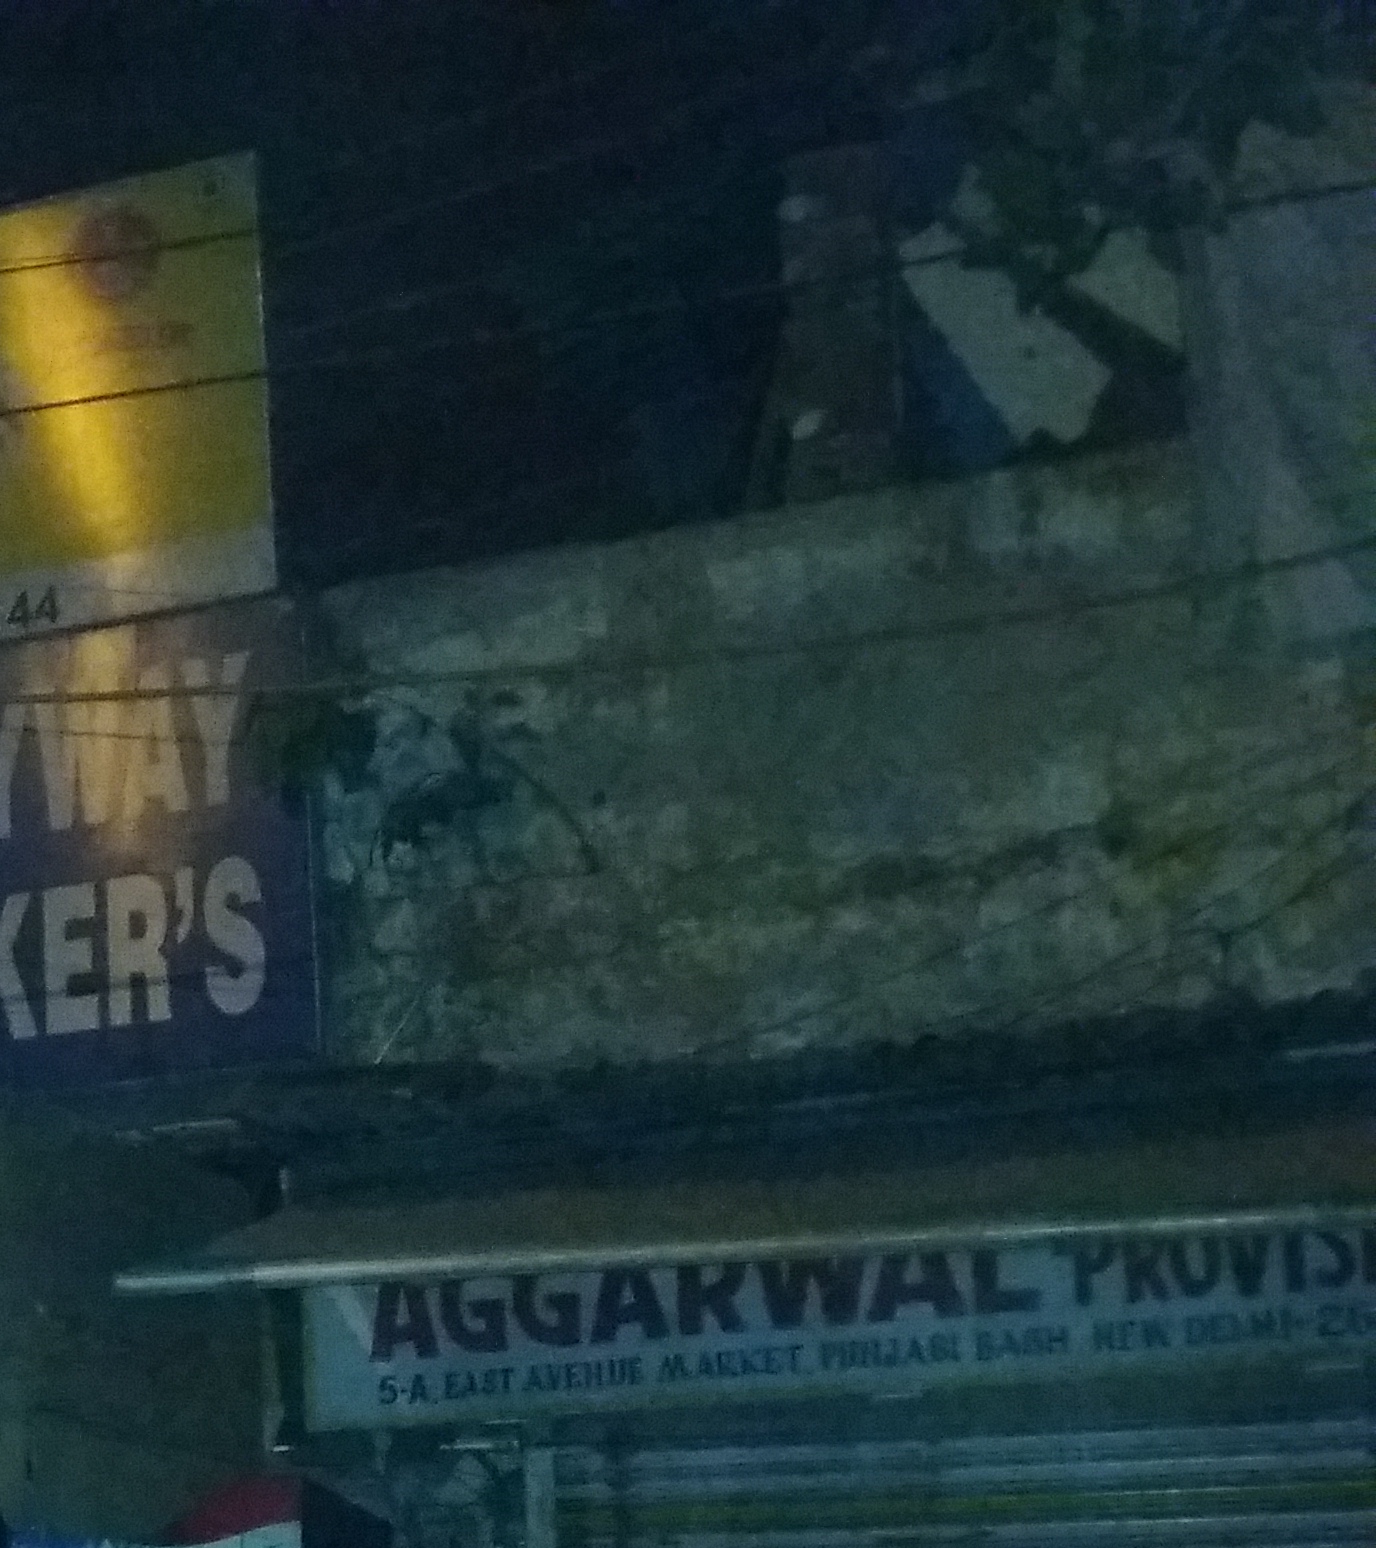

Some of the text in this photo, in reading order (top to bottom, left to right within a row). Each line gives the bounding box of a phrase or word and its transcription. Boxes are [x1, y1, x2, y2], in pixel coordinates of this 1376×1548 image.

[369, 1249, 1042, 1362] AGGARWAL
[444, 1363, 516, 1401] EAST
[522, 1354, 643, 1394] AVENUE
[658, 1343, 804, 1385] MARKET
